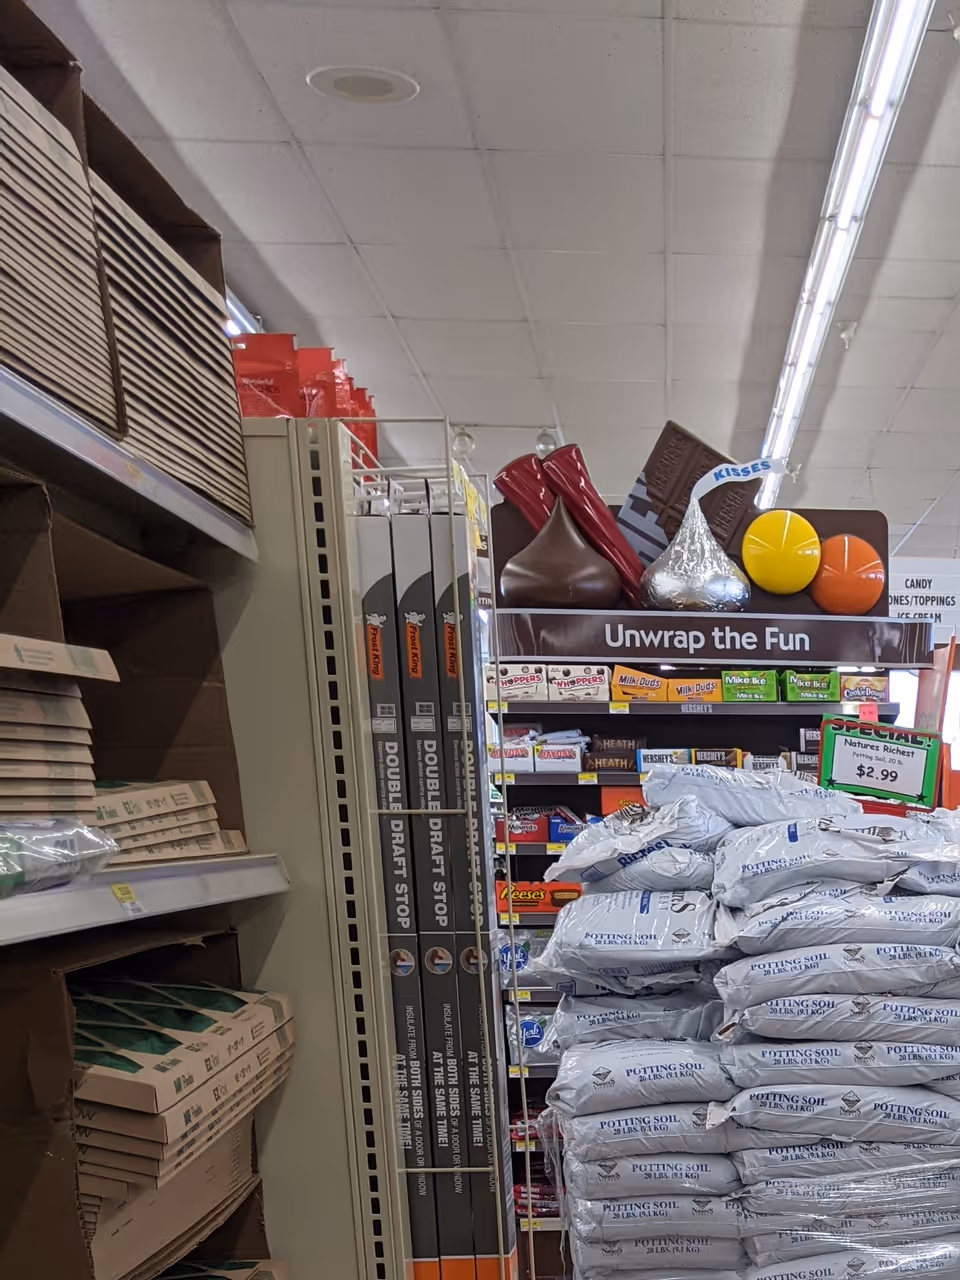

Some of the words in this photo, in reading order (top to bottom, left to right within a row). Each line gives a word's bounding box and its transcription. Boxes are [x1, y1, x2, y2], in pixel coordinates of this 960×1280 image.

[713, 460, 771, 481] KISSES
[905, 579, 932, 589] CANDY
[371, 627, 380, 652] Frost
[409, 625, 418, 651] Frost
[448, 624, 457, 650] Frost
[605, 624, 705, 654] Unwrap
[712, 625, 758, 651] the
[765, 626, 810, 651] Fun
[372, 653, 380, 675] King
[411, 652, 419, 674] King
[449, 652, 457, 674] King
[618, 675, 638, 686] Milk
[638, 677, 662, 689] Duds
[694, 681, 716, 693] Duds
[725, 676, 750, 685] Mike
[752, 677, 767, 685] Ike
[813, 680, 828, 689] Ike
[844, 689, 866, 699] Cookie
[681, 704, 713, 713] HERSHEY'S
[603, 739, 636, 750] HEATH
[844, 738, 880, 752] Natures
[883, 744, 916, 758] Richest
[595, 758, 628, 769] HEATH
[642, 755, 674, 764] HERSHEY'S
[696, 752, 726, 762] HERSHEY'S
[852, 751, 873, 762] Potting
[385, 741, 403, 812] DOUBLE
[423, 739, 442, 811] DOUBLE
[856, 763, 899, 782] $2.99
[390, 819, 408, 879] DRAFT
[429, 818, 446, 877] DRAFT
[501, 885, 546, 901] Reese's
[395, 882, 411, 929] STOP
[433, 880, 449, 927] STOP
[585, 932, 633, 941] POTTING
[635, 933, 658, 941] SOIL
[750, 959, 803, 971] POTTING
[803, 952, 830, 962] SOIL
[443, 1003, 454, 1036] INSULATE
[883, 1003, 932, 1016] POTTING
[933, 1008, 960, 1018] SOIL
[405, 1005, 416, 1038] INSULATE
[408, 1039, 418, 1058] FROM
[445, 1037, 455, 1057] FROM
[761, 1050, 812, 1058] POTTING
[814, 1048, 841, 1057] SOIL
[886, 1046, 940, 1054] POTTING
[432, 1051, 443, 1064] AT
[468, 1051, 478, 1064] AT
[410, 1060, 422, 1087] BOTH
[433, 1065, 445, 1086] THE
[447, 1058, 459, 1085] BOTH
[469, 1065, 480, 1086] THE
[626, 1063, 676, 1077] POTTING
[679, 1063, 706, 1071] SOIL
[412, 1089, 424, 1118] SIDES
[435, 1087, 447, 1117] SAME
[449, 1087, 461, 1117] SIDES
[470, 1087, 482, 1117] SAME
[750, 1092, 799, 1104] POTTING
[801, 1096, 828, 1107] SOIL
[873, 1102, 922, 1117] POTTING
[924, 1108, 950, 1119] SOIL
[414, 1121, 423, 1129] OF
[451, 1118, 460, 1126] OF
[600, 1117, 650, 1130] POTTING
[653, 1115, 681, 1124] SOIL
[437, 1118, 449, 1147] TIME!
[471, 1118, 483, 1147] TIME!
[416, 1136, 425, 1154] DOOR
[452, 1134, 461, 1151] DOOR
[417, 1155, 425, 1166] OR
[453, 1153, 462, 1164] OR
[632, 1164, 682, 1172] POTTING
[685, 1163, 711, 1172] SOIL
[603, 1202, 650, 1213] POTTING
[653, 1201, 679, 1210] SOIL
[808, 1268, 835, 1279] SOIL
